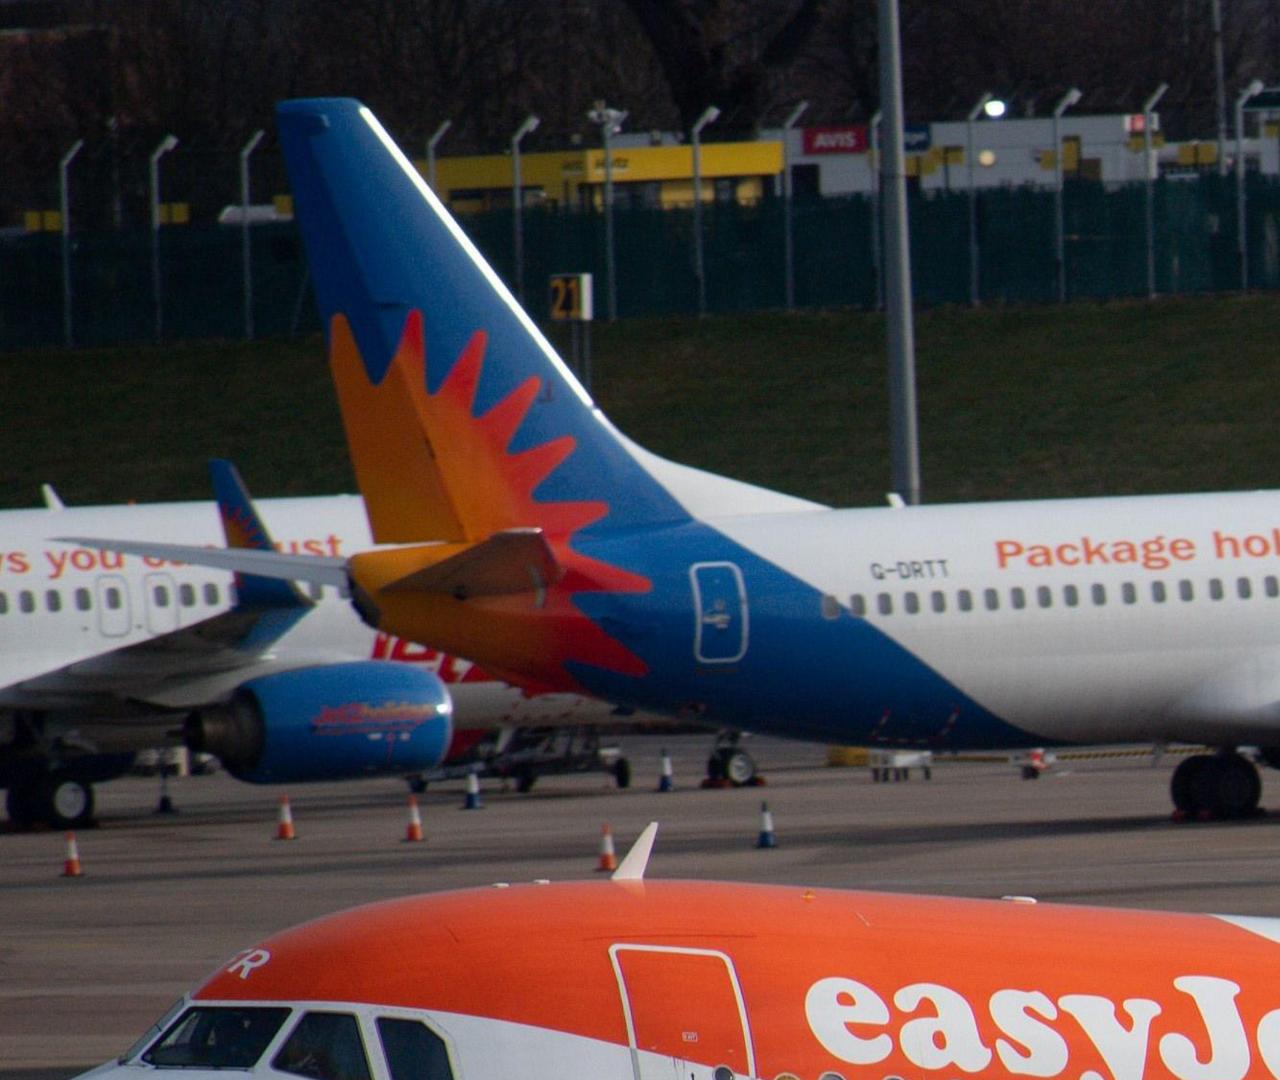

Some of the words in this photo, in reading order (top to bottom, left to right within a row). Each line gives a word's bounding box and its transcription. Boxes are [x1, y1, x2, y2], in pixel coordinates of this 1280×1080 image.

[815, 131, 857, 148] AVIS
[550, 278, 580, 320] 21
[45, 548, 125, 579] you
[994, 536, 1197, 570] Package
[869, 559, 949, 580] G-DRTT
